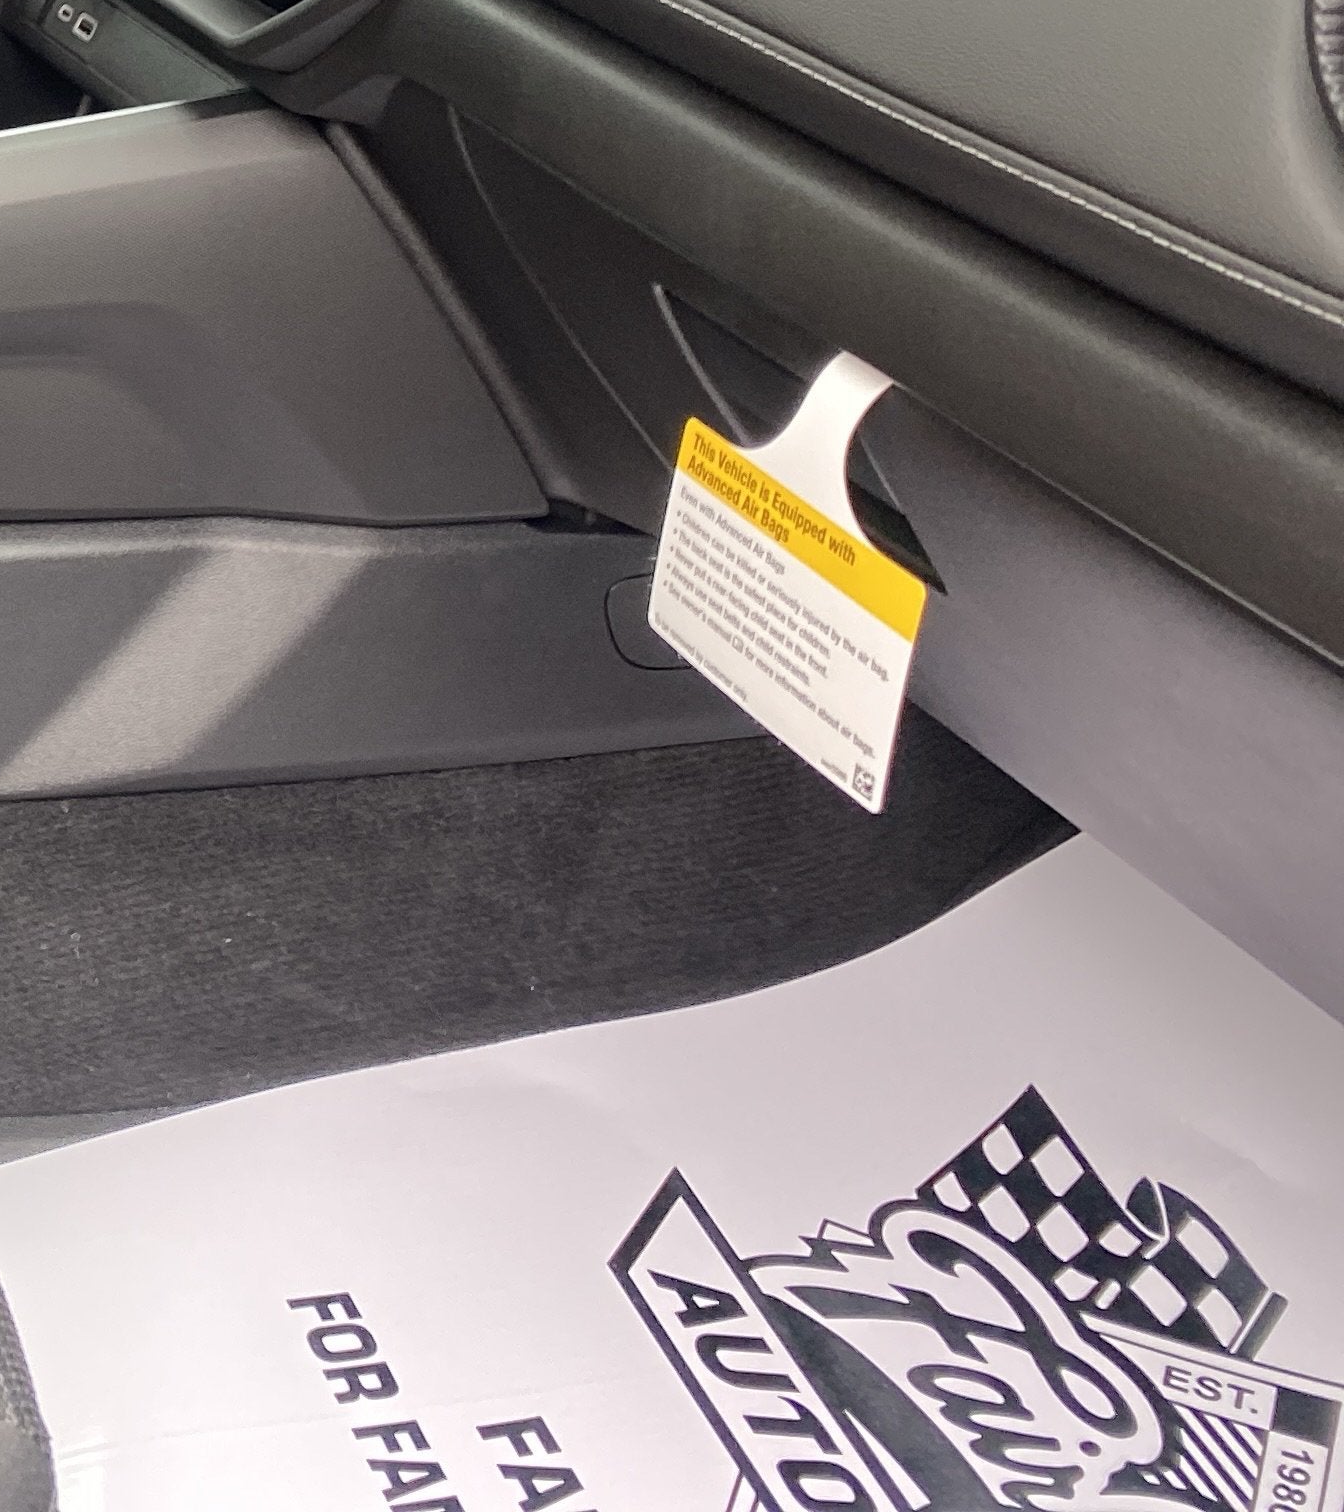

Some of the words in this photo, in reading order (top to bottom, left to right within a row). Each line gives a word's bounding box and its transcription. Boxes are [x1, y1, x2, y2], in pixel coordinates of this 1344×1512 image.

[680, 485, 698, 508] Even
[698, 499, 715, 522] with
[715, 512, 753, 550] Advanced
[752, 540, 765, 560] Air
[764, 550, 786, 578] Bags
[686, 452, 741, 507] Advanced
[740, 492, 759, 520] Air
[759, 506, 791, 547] Bags
[692, 432, 716, 464] This
[716, 450, 759, 495] Vehicle
[758, 480, 771, 504] is
[770, 490, 827, 549] Equipped
[827, 532, 857, 567] with
[670, 565, 694, 593] Always
[694, 585, 707, 603] use
[707, 595, 723, 616] seat
[723, 608, 741, 631] belts
[741, 622, 755, 642] and
[755, 634, 773, 657] child
[674, 548, 694, 571] Never
[693, 563, 706, 583] put
[706, 575, 711, 585] a
[749, 608, 768, 632] child
[768, 624, 785, 645] seat
[784, 636, 793, 652] in
[793, 643, 807, 662] the
[678, 530, 690, 548] The
[690, 540, 708, 562] back
[707, 554, 723, 574] seat
[723, 566, 730, 580] is
[731, 571, 743, 590] the
[743, 581, 765, 608] safest
[765, 599, 786, 626] place
[786, 616, 798, 633] for
[681, 512, 711, 543] Children
[710, 536, 725, 555] can
[725, 546, 735, 563] be
[735, 554, 757, 579] killed
[756, 572, 766, 587] or
[766, 578, 801, 616] seriously
[801, 605, 830, 638] injured
[829, 628, 841, 648] by
[842, 636, 856, 657] the
[856, 648, 869, 667] air
[706, 615, 732, 644] manual
[744, 645, 754, 662] for
[754, 656, 774, 679] more
[774, 671, 816, 714] information
[816, 705, 840, 732] about
[839, 723, 852, 741] air
[286, 1291, 400, 1405] FOR
[647, 1268, 879, 1512] AUTO
[1163, 1365, 1258, 1414] EST.
[475, 1414, 599, 1512] FA
